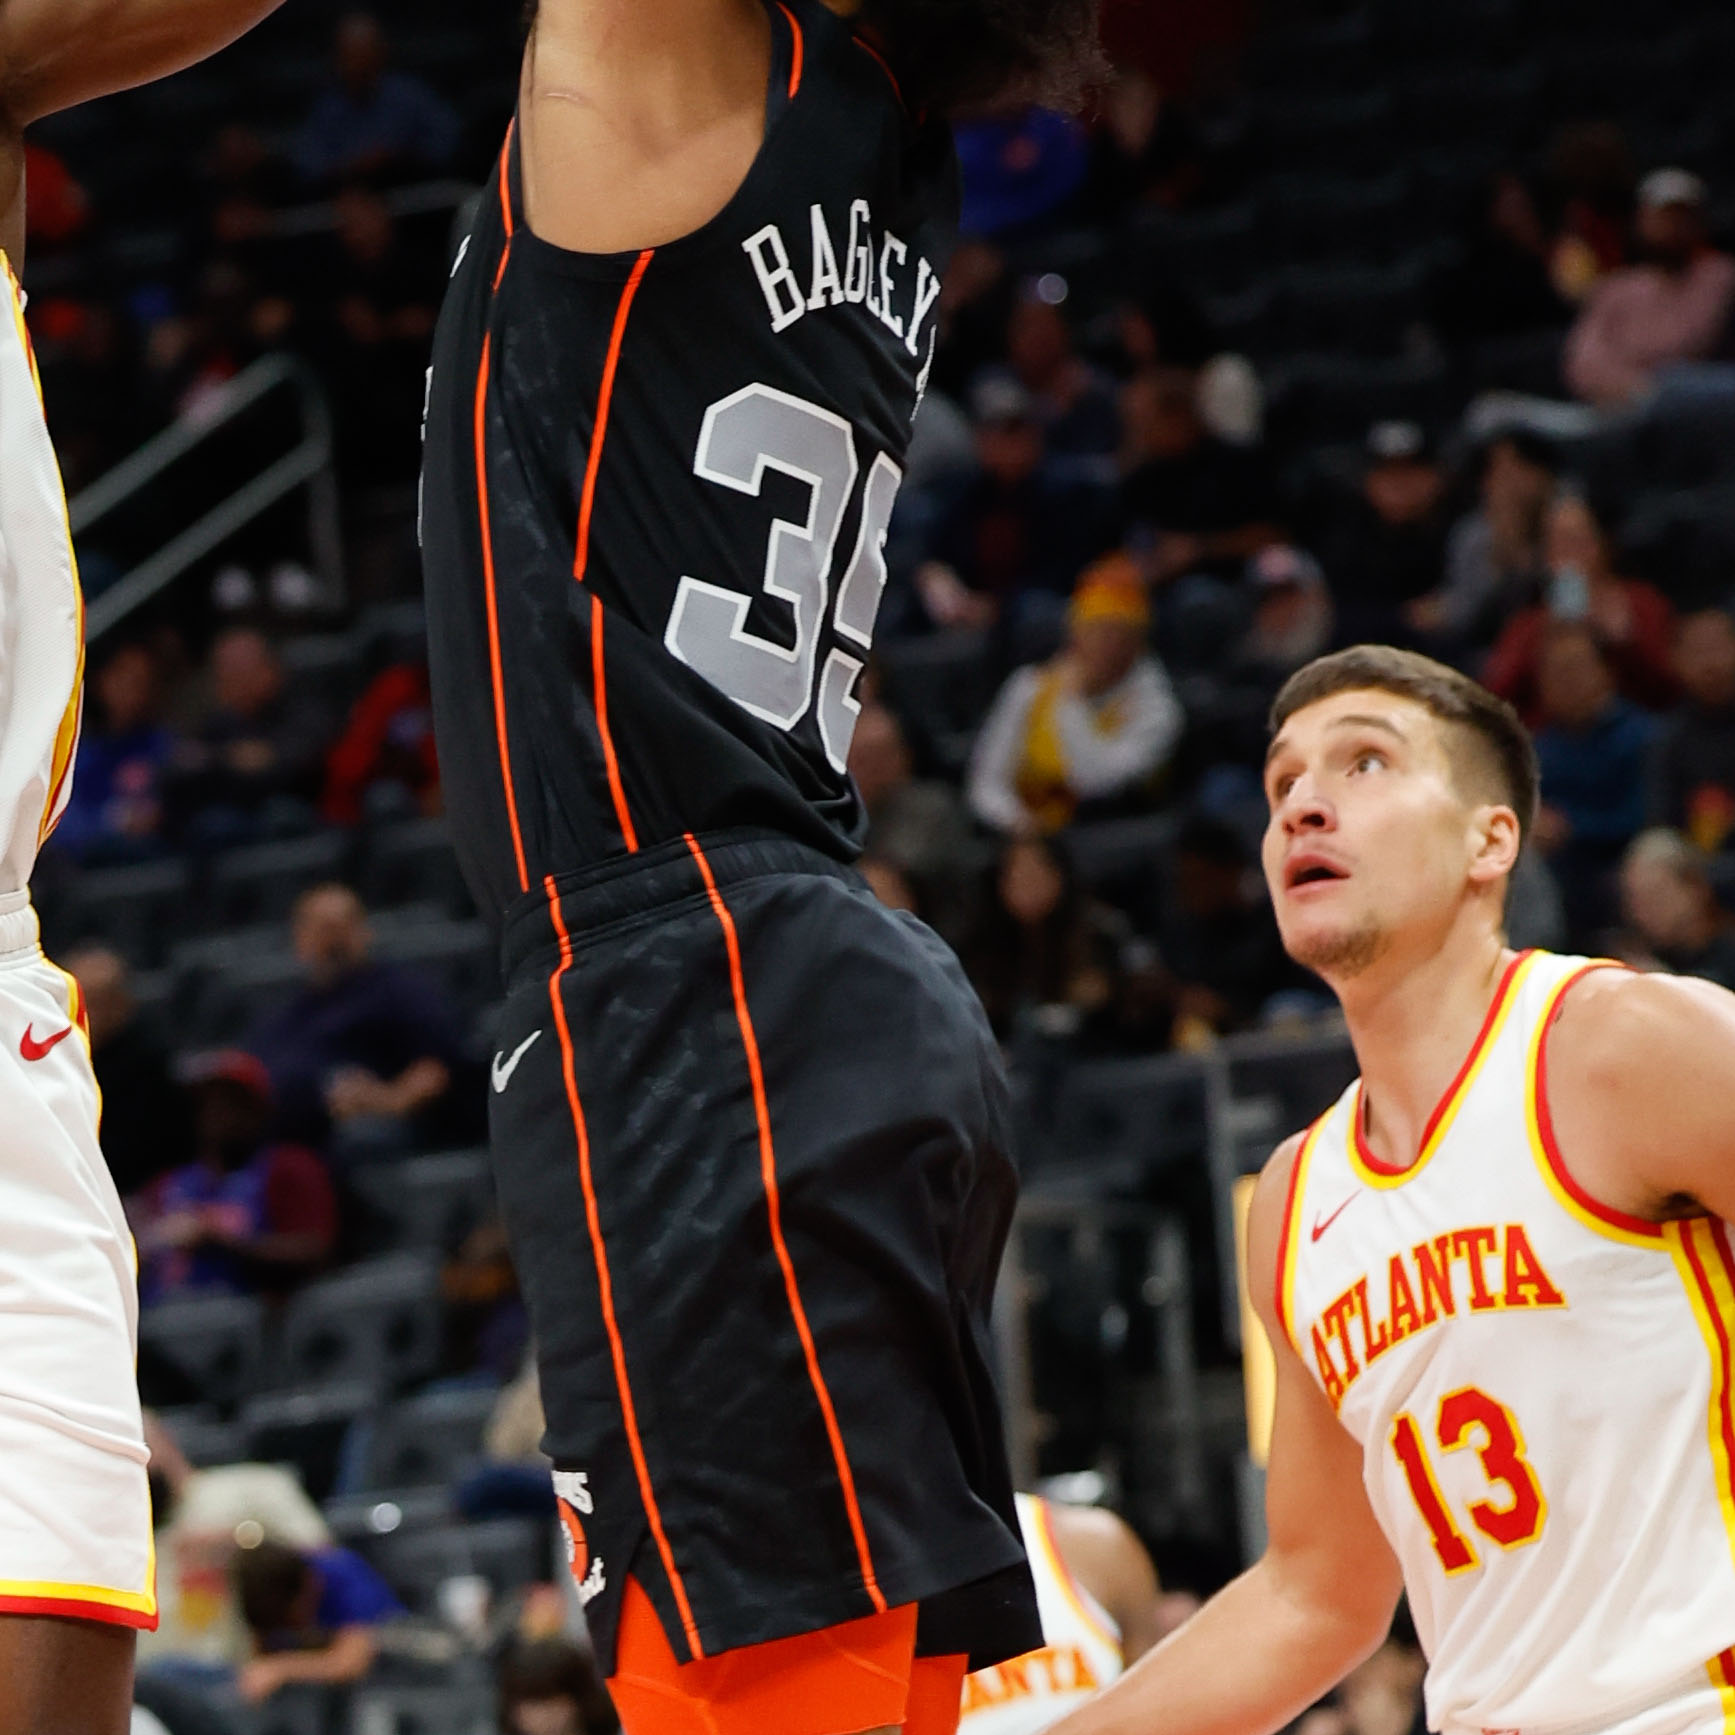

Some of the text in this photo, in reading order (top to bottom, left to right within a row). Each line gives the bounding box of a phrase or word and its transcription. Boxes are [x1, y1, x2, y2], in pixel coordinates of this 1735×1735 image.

[741, 198, 943, 357] BAGLEY
[1311, 1222, 1569, 1419] ATLANTA
[1388, 1382, 1549, 1576] 13
[961, 1643, 1101, 1716] ANTA
